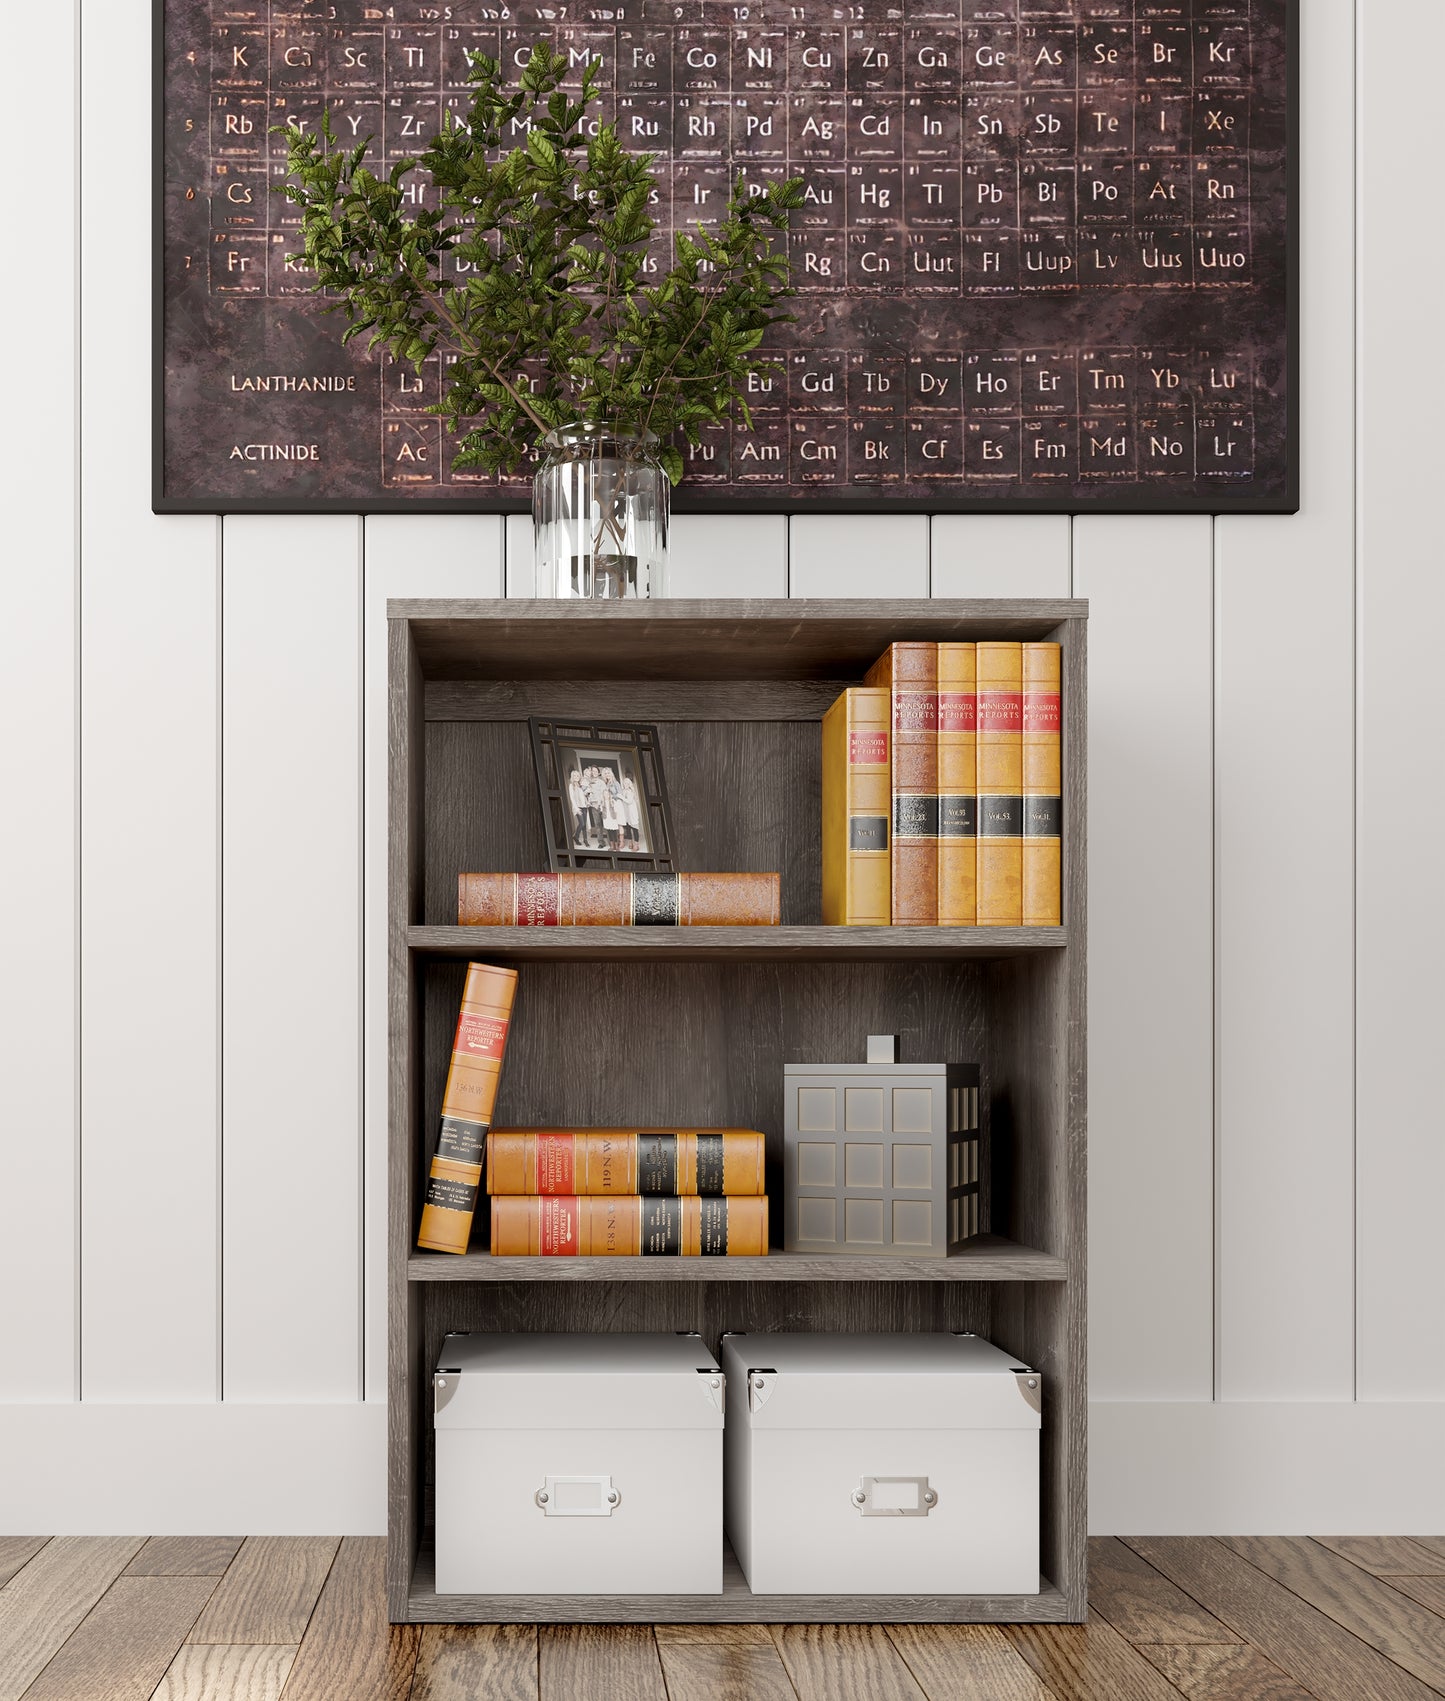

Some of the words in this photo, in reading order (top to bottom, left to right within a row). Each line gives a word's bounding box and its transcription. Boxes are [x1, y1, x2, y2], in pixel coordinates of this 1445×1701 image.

[233, 46, 248, 67] K
[283, 47, 313, 67] Ca
[344, 47, 368, 67] Sc
[513, 48, 534, 68] C
[633, 48, 657, 68] Fe
[686, 47, 717, 68] Co
[802, 47, 831, 68] Cu
[862, 47, 889, 68] Zn
[917, 47, 947, 68] Ga
[975, 46, 1005, 67] Ge
[1035, 46, 1063, 65] As
[1094, 44, 1118, 64] Se
[1153, 44, 1176, 63] Br
[1209, 42, 1235, 62] Kr
[225, 114, 253, 135] Rb
[347, 115, 362, 136] Y
[400, 116, 426, 136] Zr
[511, 116, 541, 136] M
[631, 116, 659, 137] Ru
[688, 116, 716, 137] Rh
[747, 116, 773, 137] Pd
[801, 116, 833, 140] Ag
[859, 116, 890, 136] Cd
[923, 116, 943, 135] In
[977, 115, 1002, 135] Sn
[1034, 114, 1061, 134] Sb
[1092, 112, 1119, 132] Te
[1207, 111, 1235, 130] Xe
[227, 184, 252, 203] Cs
[693, 184, 711, 205] Ir
[804, 184, 833, 204] Au
[860, 184, 890, 208] Hg
[977, 184, 1002, 203] Pb
[1038, 182, 1057, 202] Bi
[1093, 181, 1118, 201] Po
[1150, 182, 1176, 200] At
[1208, 180, 1234, 199] Rn
[228, 252, 249, 272] Fr
[805, 253, 831, 276] Rg
[861, 253, 890, 272] Cn
[1026, 251, 1071, 273] Uup
[1095, 249, 1119, 269] Lv
[1142, 249, 1183, 268] Uus
[1200, 248, 1246, 267] Uuo
[231, 375, 356, 393] LANTHANIDE
[400, 373, 424, 393] La
[748, 373, 772, 392] Eu
[802, 372, 834, 392] Gd
[862, 373, 890, 393] Tb
[920, 373, 948, 396] Dy
[976, 373, 1008, 394] Ho
[1039, 371, 1061, 391] Er
[1089, 369, 1125, 390] Tm
[1151, 368, 1179, 390] Yb
[1211, 368, 1235, 389] Lu
[230, 444, 320, 460] ACTINIDE
[396, 442, 427, 462] Ac
[689, 443, 714, 461] Pu
[740, 443, 779, 461] Am
[801, 441, 836, 461] Cm
[864, 441, 889, 460] Bk
[921, 440, 947, 460] Cf
[983, 441, 1003, 460] Es
[1035, 439, 1066, 459] Fm
[1091, 437, 1126, 457] Md
[1151, 436, 1184, 457] No
[1214, 435, 1236, 457] Lr
[603, 1169, 611, 1188] 119
